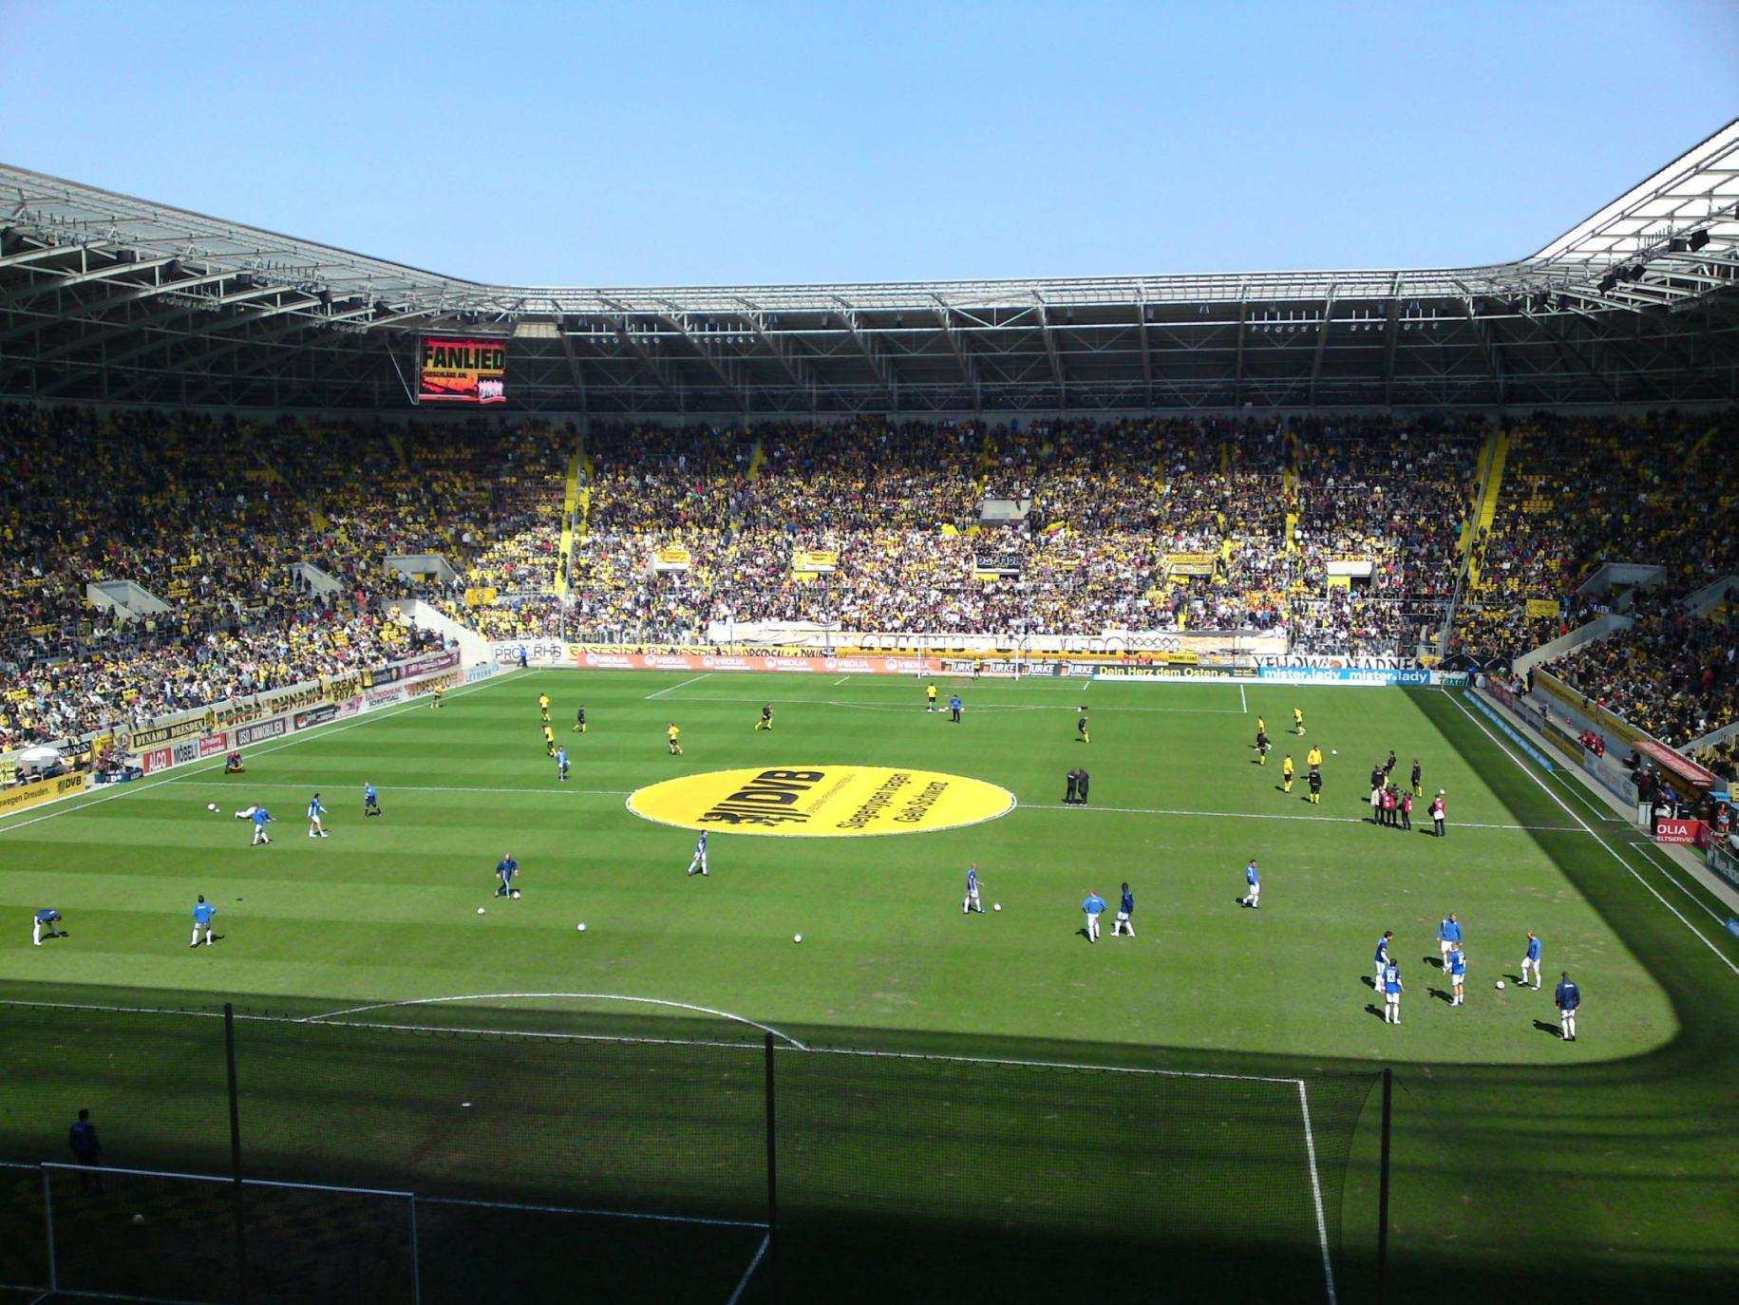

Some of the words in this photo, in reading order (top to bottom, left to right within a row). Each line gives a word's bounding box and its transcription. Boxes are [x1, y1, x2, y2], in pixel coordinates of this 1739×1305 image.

[424, 348, 505, 369] FANLIED
[1100, 666, 1125, 676] Dein
[1128, 667, 1153, 677] Herz
[1156, 667, 1181, 677] dem
[148, 750, 167, 772] ALCO
[65, 776, 82, 790] DVB
